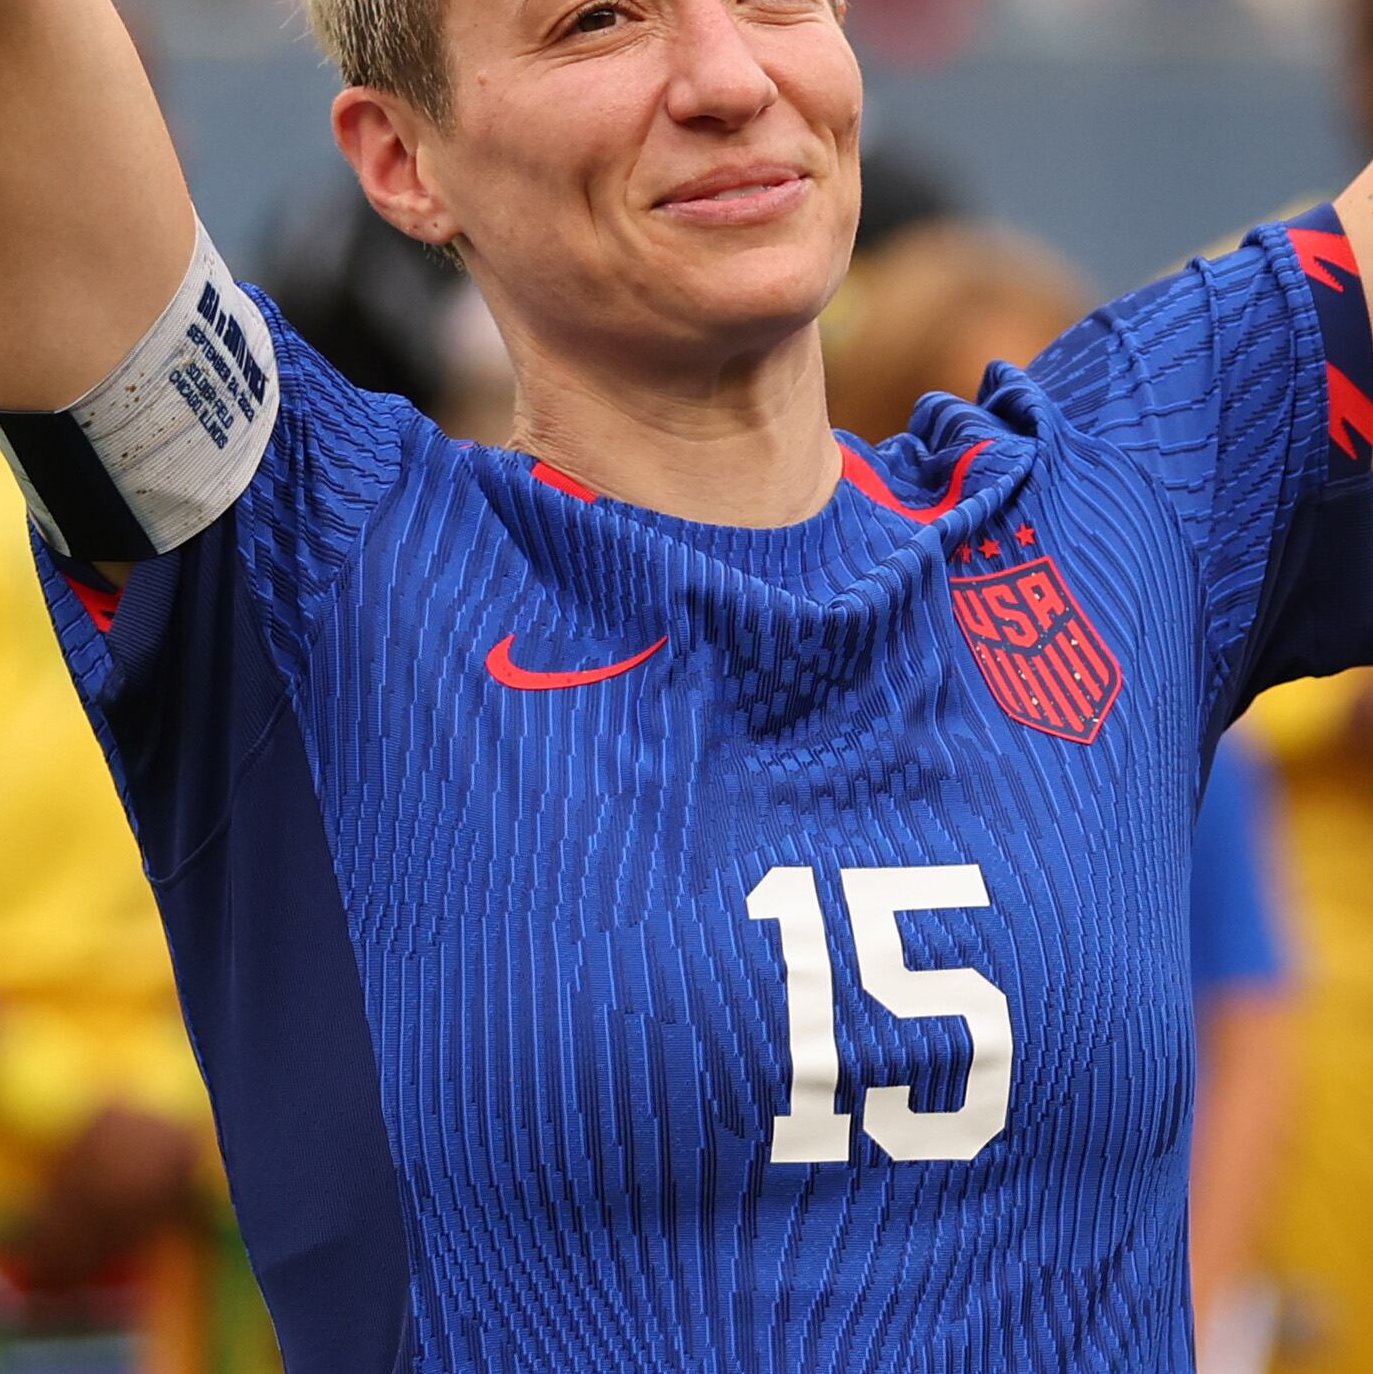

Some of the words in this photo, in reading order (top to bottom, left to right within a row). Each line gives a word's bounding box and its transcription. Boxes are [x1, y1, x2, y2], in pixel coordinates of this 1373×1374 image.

[187, 323, 232, 384] SEPTEMBER
[186, 363, 217, 403] SOLDIER
[212, 398, 234, 430] FIELD
[198, 409, 229, 450] ILLINOIS
[951, 570, 1066, 648] USA
[745, 863, 1014, 1163] 15
